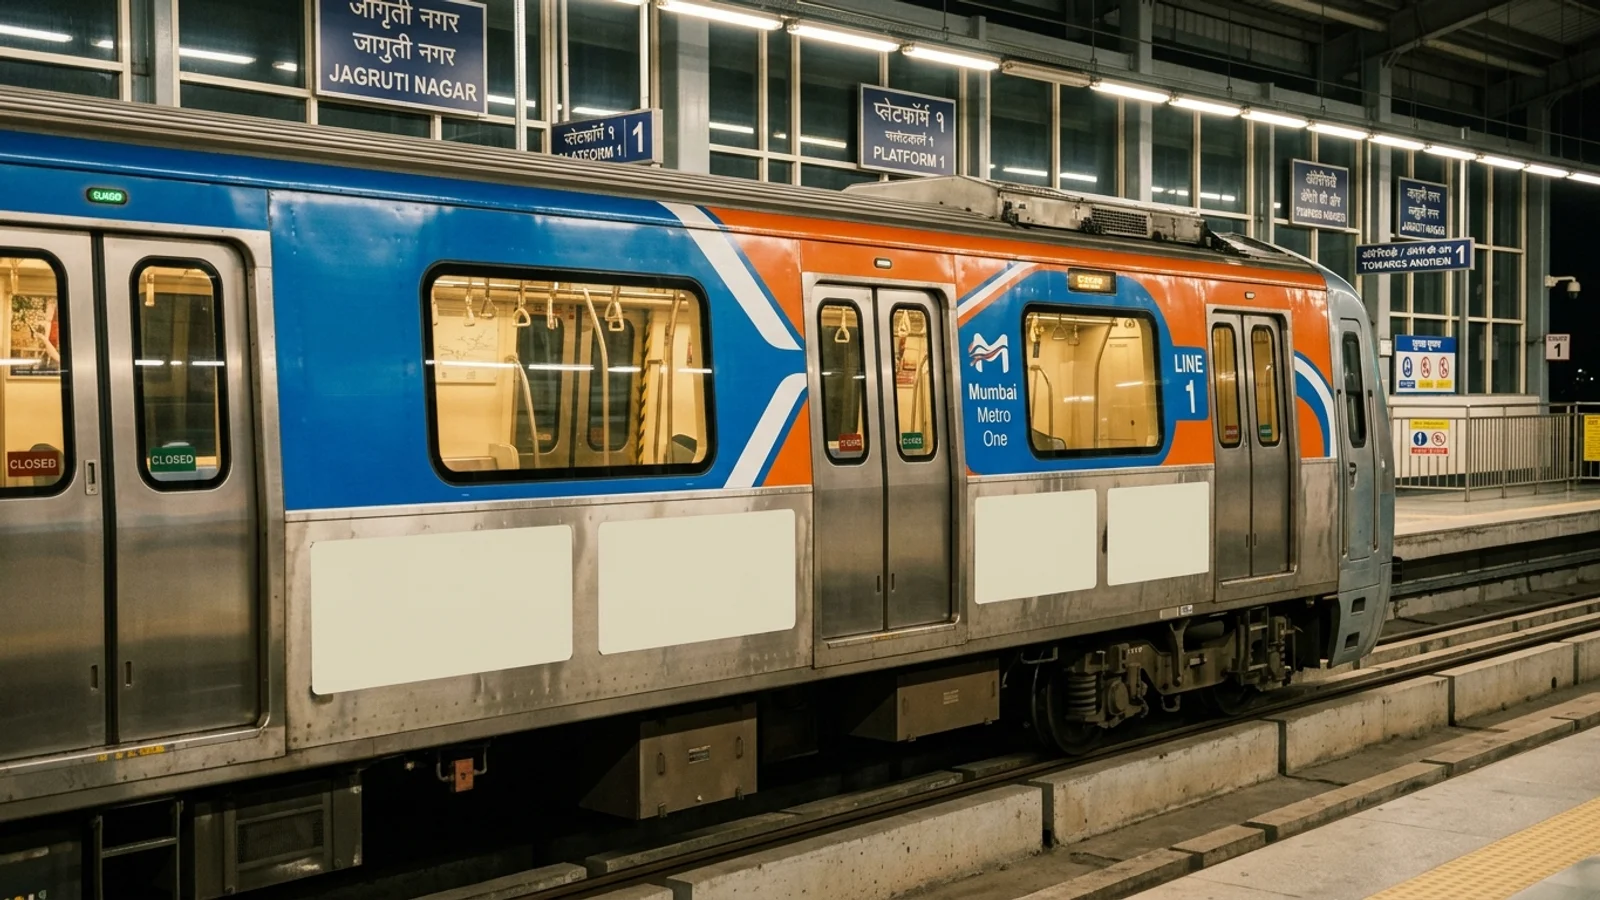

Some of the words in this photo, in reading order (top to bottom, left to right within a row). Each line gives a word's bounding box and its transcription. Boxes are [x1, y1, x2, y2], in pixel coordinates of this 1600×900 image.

[419, 8, 460, 33] नगर
[418, 43, 456, 66] नगर
[329, 63, 409, 92] JAGRUTI
[414, 75, 477, 102] NAGAR
[632, 121, 644, 153] 1
[617, 144, 621, 156] 1
[874, 145, 936, 168] PLATFORM
[939, 155, 945, 169] 1
[1455, 244, 1465, 264] 1
[1554, 342, 1561, 357] 1
[1174, 354, 1203, 373] LINE
[968, 383, 1017, 400] Mumbai
[1185, 380, 1195, 413] 1
[977, 406, 1011, 423] Metro
[983, 430, 1008, 447] One
[10, 458, 57, 470] CLOSED
[152, 454, 194, 465] CLOSED
